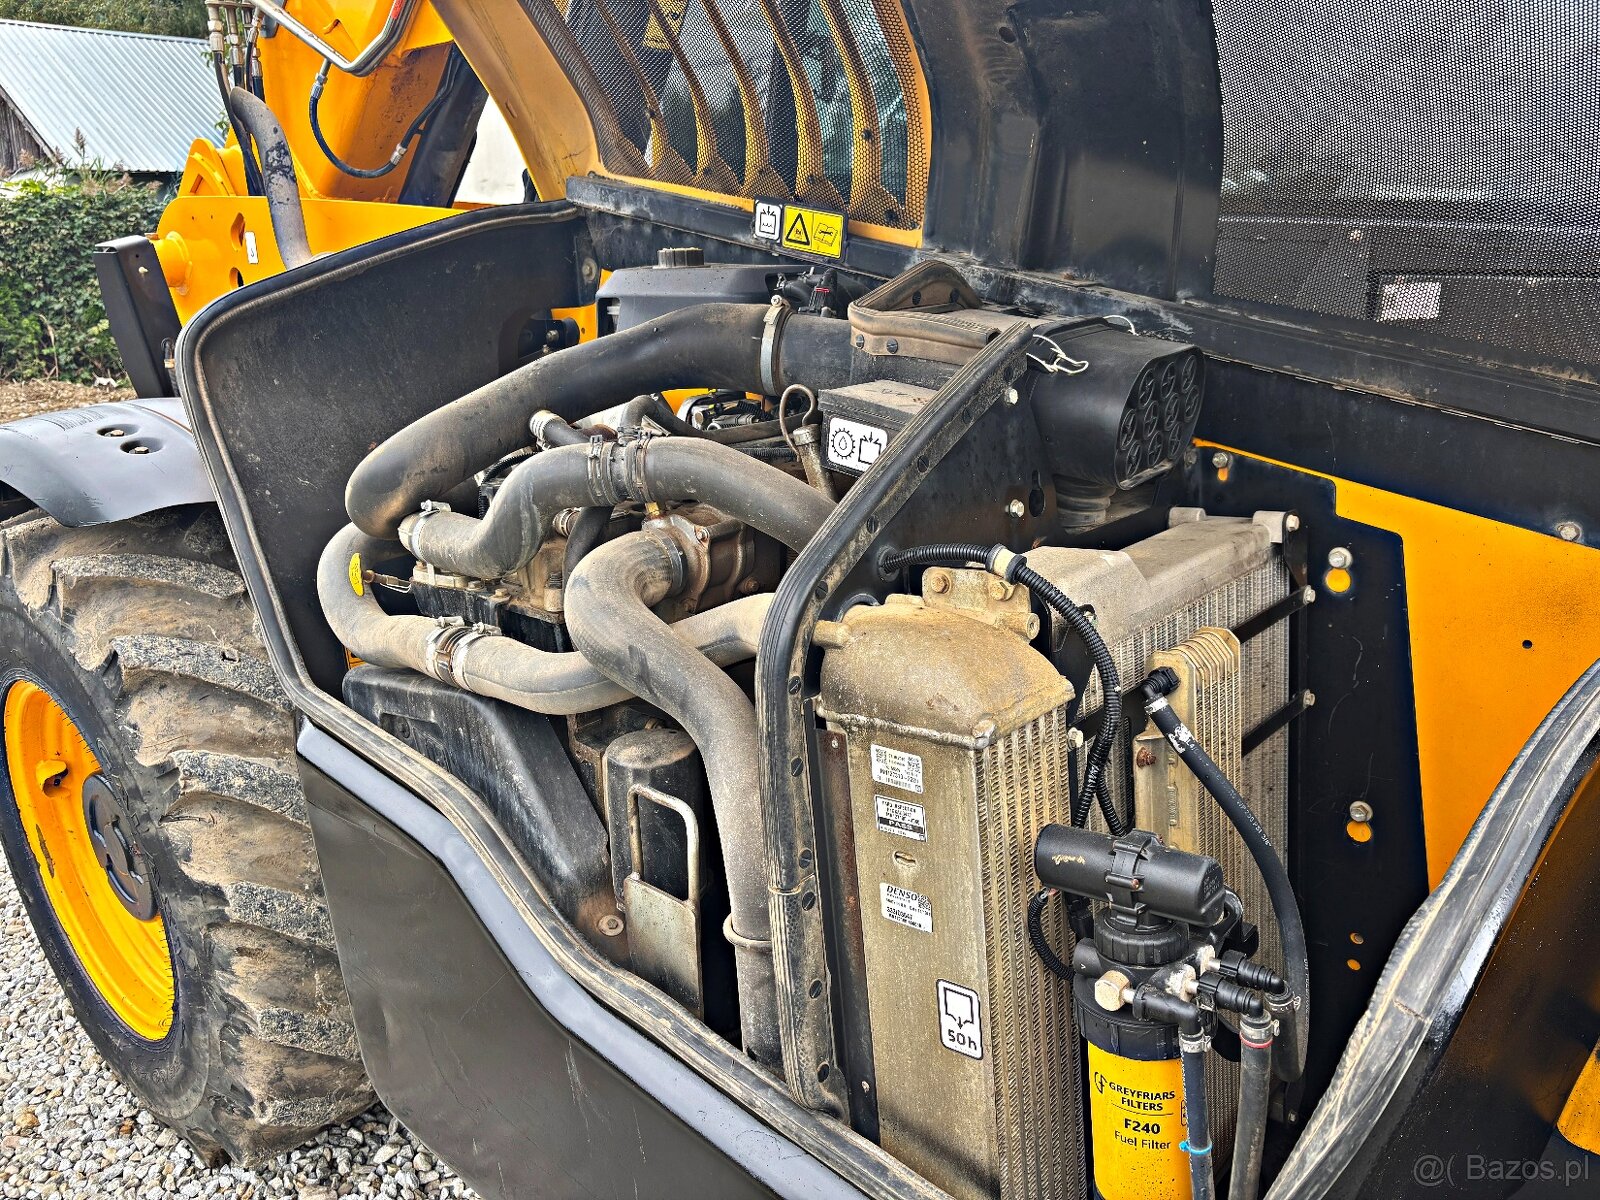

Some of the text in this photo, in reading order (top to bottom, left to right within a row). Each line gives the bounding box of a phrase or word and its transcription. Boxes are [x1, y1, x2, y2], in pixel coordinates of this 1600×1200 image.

[886, 885, 918, 900] DENSO
[1109, 1081, 1176, 1100] GREYFRIARS
[1121, 1096, 1163, 1111] FILTERS
[1124, 1118, 1161, 1135] F240
[1114, 1130, 1171, 1150] Fuel Filter
